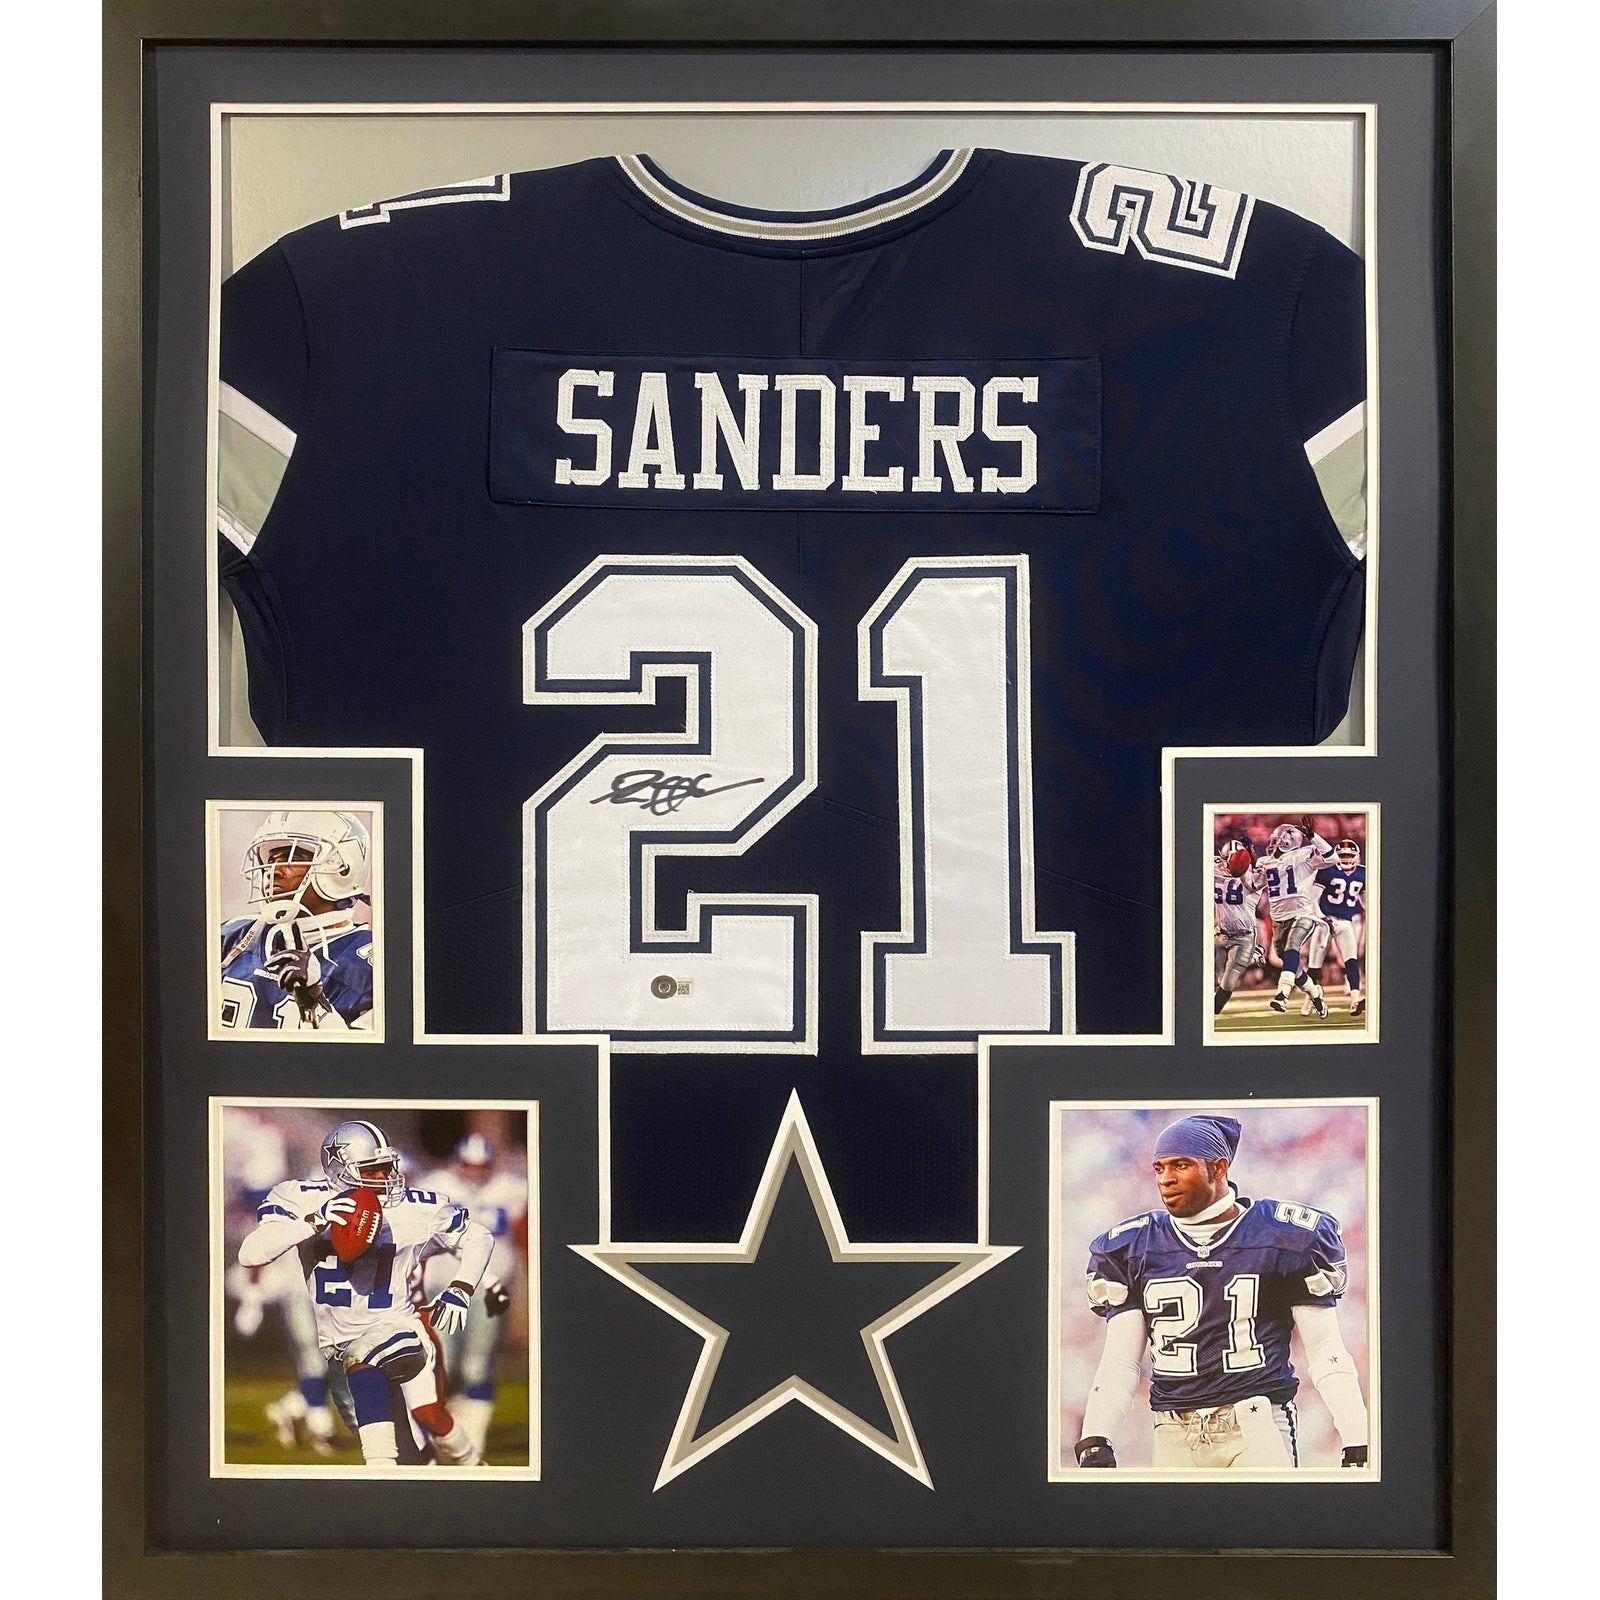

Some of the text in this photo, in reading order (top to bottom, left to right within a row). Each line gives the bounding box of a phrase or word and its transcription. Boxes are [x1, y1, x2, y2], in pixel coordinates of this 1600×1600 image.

[554, 367, 1040, 495] SANDERS
[522, 553, 1077, 1057] 21
[1265, 864, 1298, 897] 21
[1327, 877, 1364, 907] 39
[1108, 1216, 1150, 1240] 1
[1274, 1201, 1320, 1232] 2
[1143, 1274, 1266, 1377] 21
